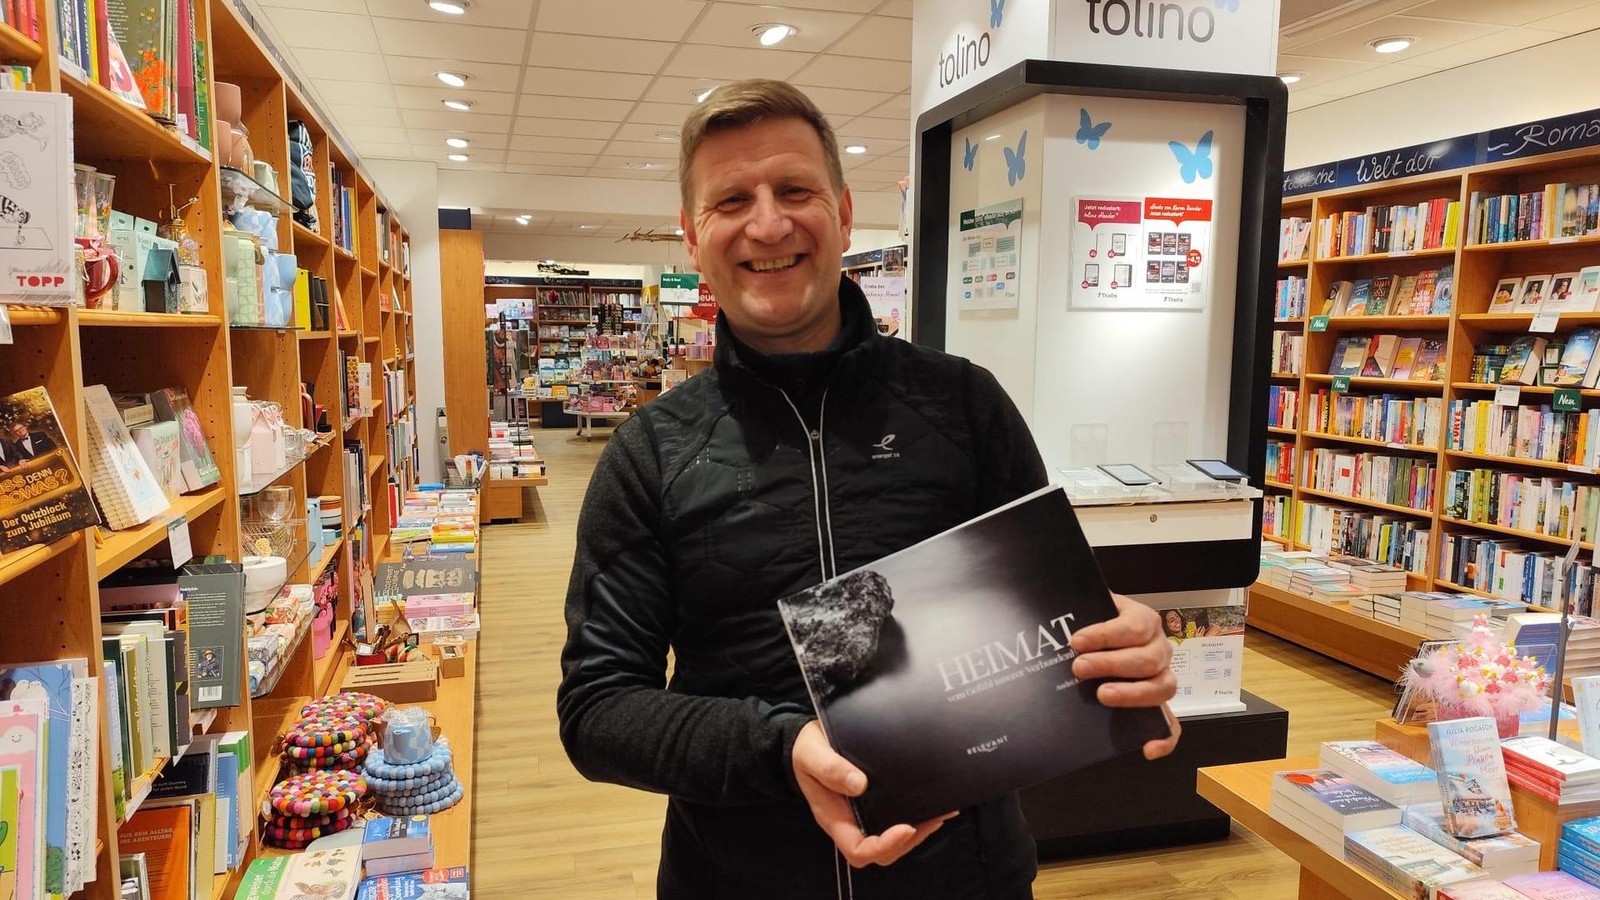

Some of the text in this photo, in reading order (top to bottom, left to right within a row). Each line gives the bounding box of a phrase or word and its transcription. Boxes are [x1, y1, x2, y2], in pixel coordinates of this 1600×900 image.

[1086, 0, 1215, 43] tolino
[939, 32, 991, 89] tolino
[1283, 151, 1443, 191] tastische Welt der
[16, 275, 65, 288] TOPP
[1558, 394, 1576, 405] Neu
[0, 468, 53, 496] ISS DENN
[0, 468, 69, 506] SOWAS?
[2, 501, 67, 530] Der Quizblock
[6, 510, 72, 538] zum Jubiläum
[936, 612, 1075, 692] HEIMAT
[1446, 724, 1494, 736] JULIA ROGASCH
[966, 735, 1009, 755] RELEVANT
